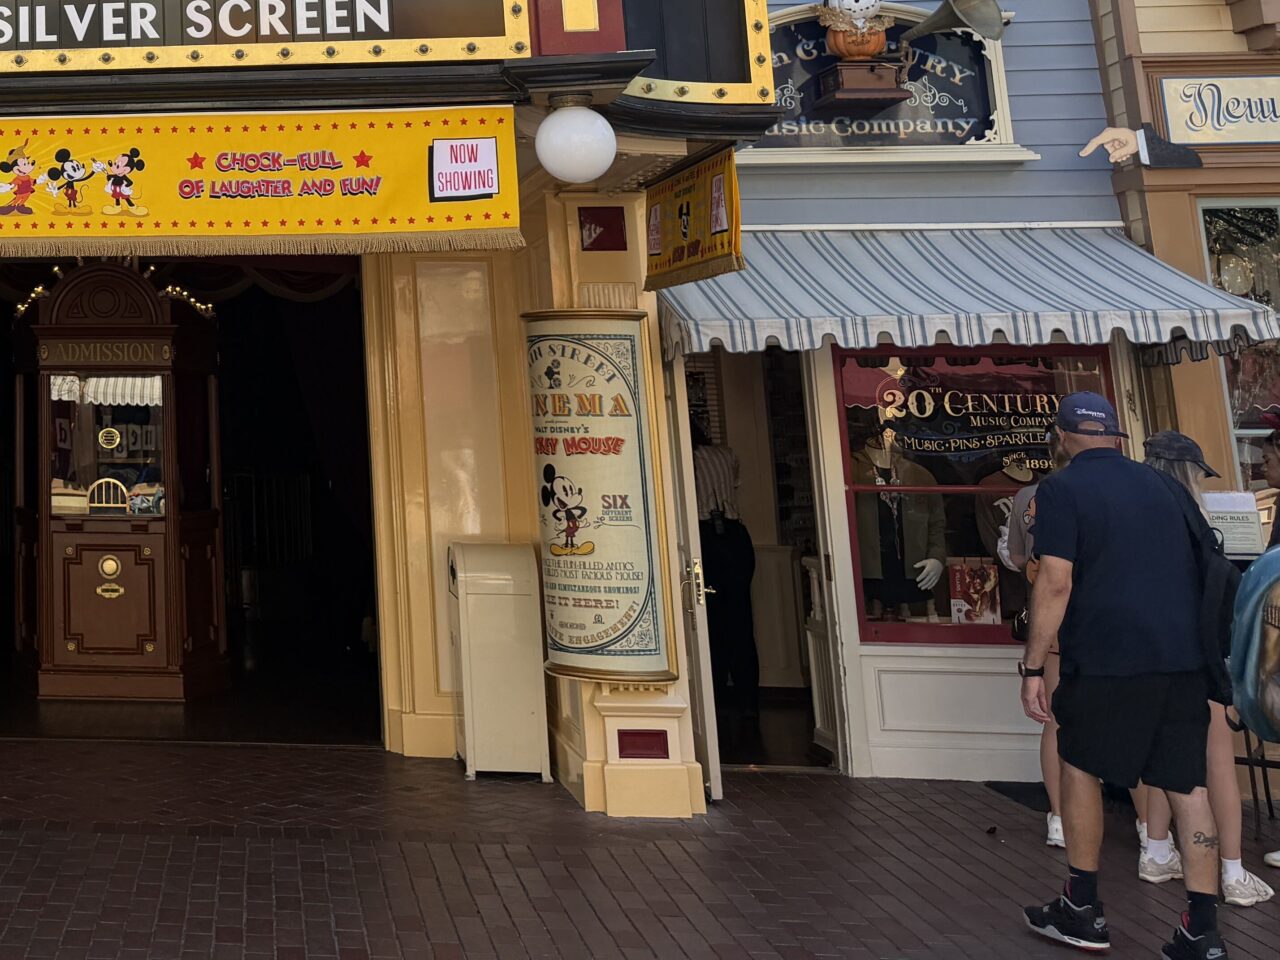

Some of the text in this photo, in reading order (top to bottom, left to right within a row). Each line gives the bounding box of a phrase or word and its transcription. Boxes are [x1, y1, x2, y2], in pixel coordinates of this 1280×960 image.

[831, 116, 978, 138] Company
[215, 149, 344, 173] CHOCK-FULL
[449, 143, 479, 164] NOW
[178, 175, 383, 199] OF LAUGHTER AND FUN!
[437, 168, 494, 191] SHOWING
[54, 342, 155, 361] ADMISSION
[548, 344, 620, 384] STREET
[532, 393, 632, 417] NEMA
[944, 390, 1064, 417] CENTURY
[550, 424, 589, 433] DISNEY'S
[970, 415, 1055, 427] MUSIC COMPAN
[563, 436, 625, 456] MOUSE
[903, 436, 944, 451] MUSIC
[949, 437, 980, 451] PINS
[1002, 451, 1026, 467] SINCE
[601, 494, 631, 509] SIX
[581, 570, 612, 580] FAMOUS
[605, 561, 634, 571] ANTICS
[558, 596, 570, 607] IT
[572, 597, 619, 609] HERE!
